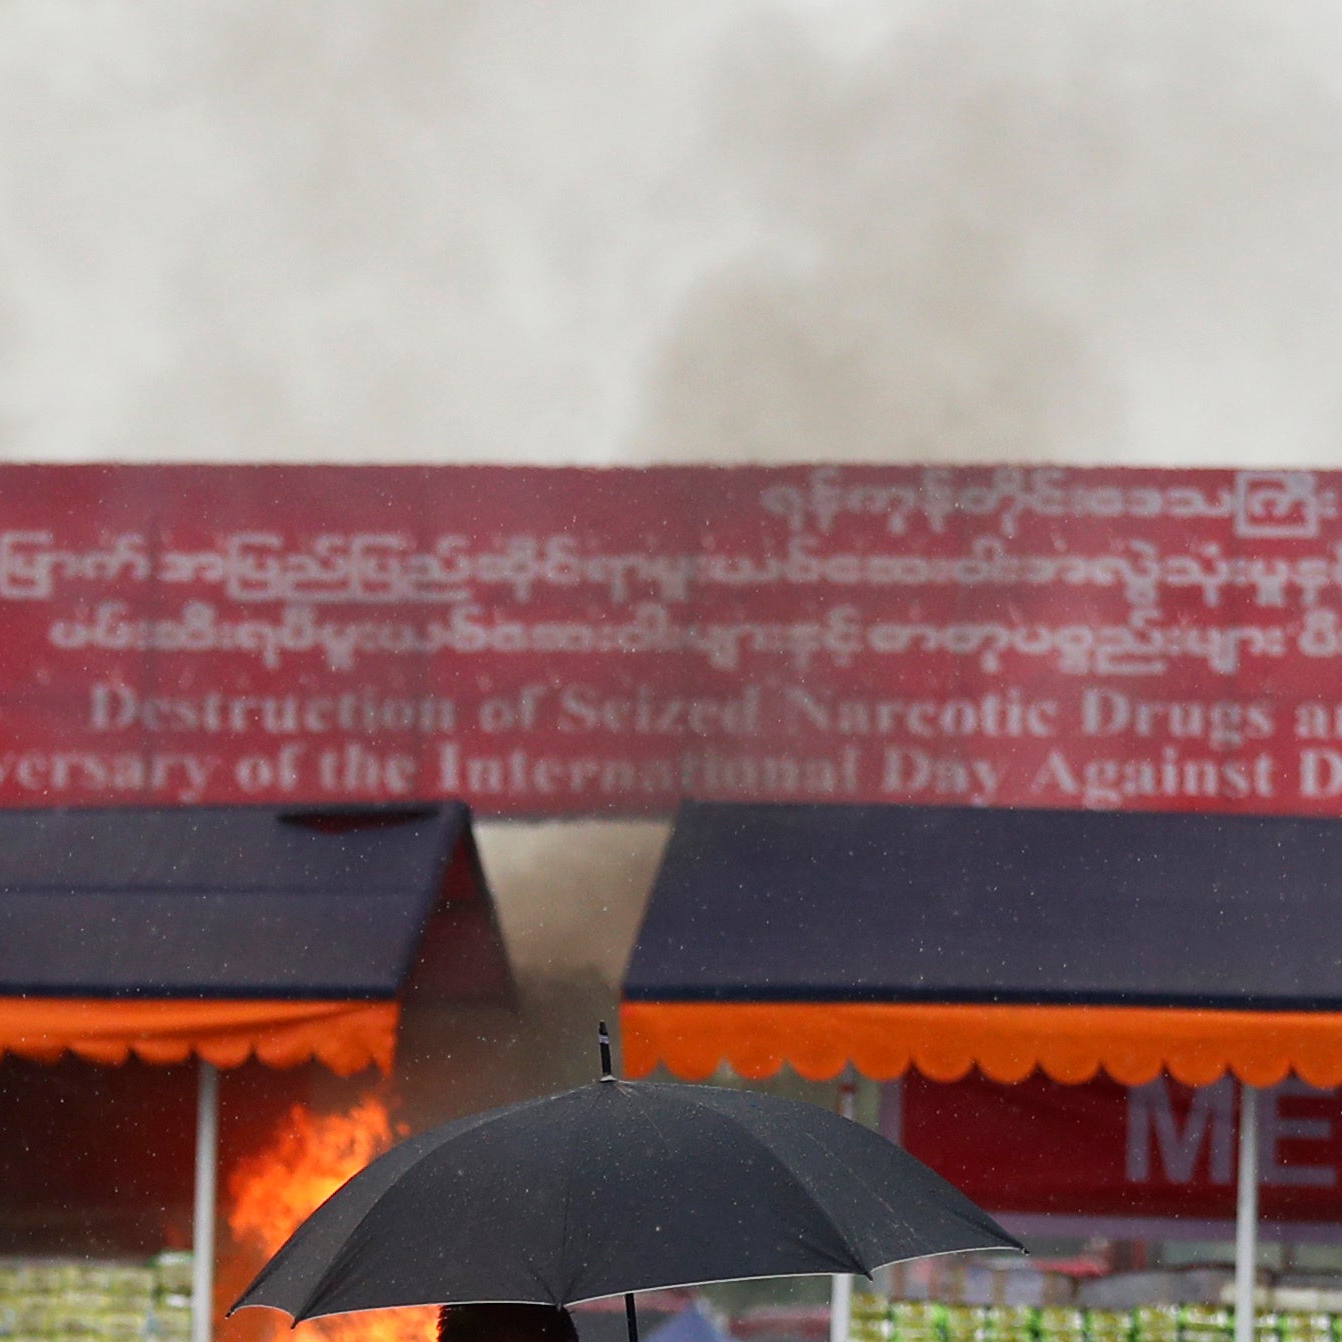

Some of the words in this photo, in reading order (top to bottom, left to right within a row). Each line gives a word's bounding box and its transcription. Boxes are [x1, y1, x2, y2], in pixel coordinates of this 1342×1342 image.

[90, 683, 457, 735] Destruction
[480, 684, 551, 736] of
[561, 686, 763, 737] Seized
[784, 687, 1058, 738] Narcotic
[1081, 688, 1275, 750] Drugs
[235, 742, 301, 792] of
[320, 742, 417, 793] the
[440, 745, 857, 795] International
[881, 748, 1004, 806] Day
[1034, 749, 1274, 810] Against
